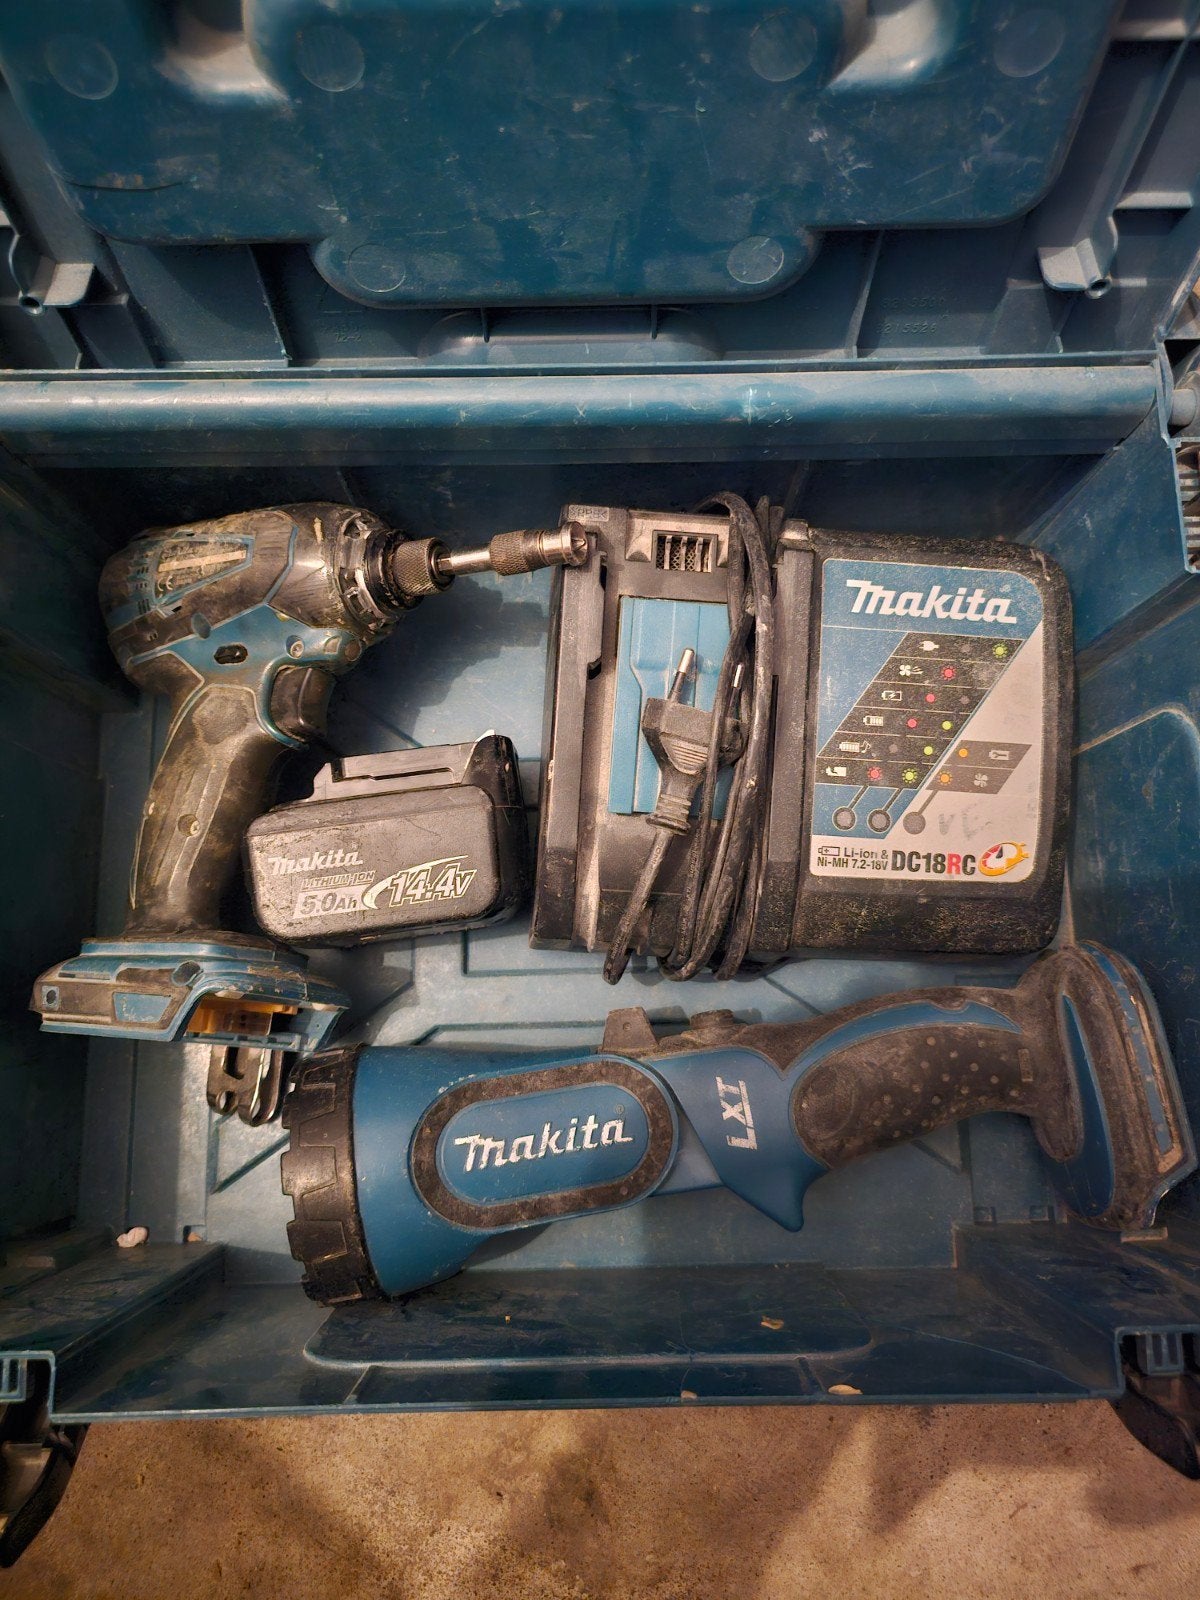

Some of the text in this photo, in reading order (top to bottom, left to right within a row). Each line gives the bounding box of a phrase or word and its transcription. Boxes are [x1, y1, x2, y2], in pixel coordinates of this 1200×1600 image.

[846, 579, 1017, 624] Makita
[268, 848, 364, 876] Makita
[817, 856, 889, 871] Ni-MH 7.2-18V
[843, 847, 889, 860] Li-ion &
[891, 849, 976, 876] DC18RC
[301, 869, 376, 888] LITHIUM-ION
[299, 891, 358, 915] 5.0Ah
[715, 1075, 758, 1150] LXT
[453, 1113, 634, 1173] Makita
